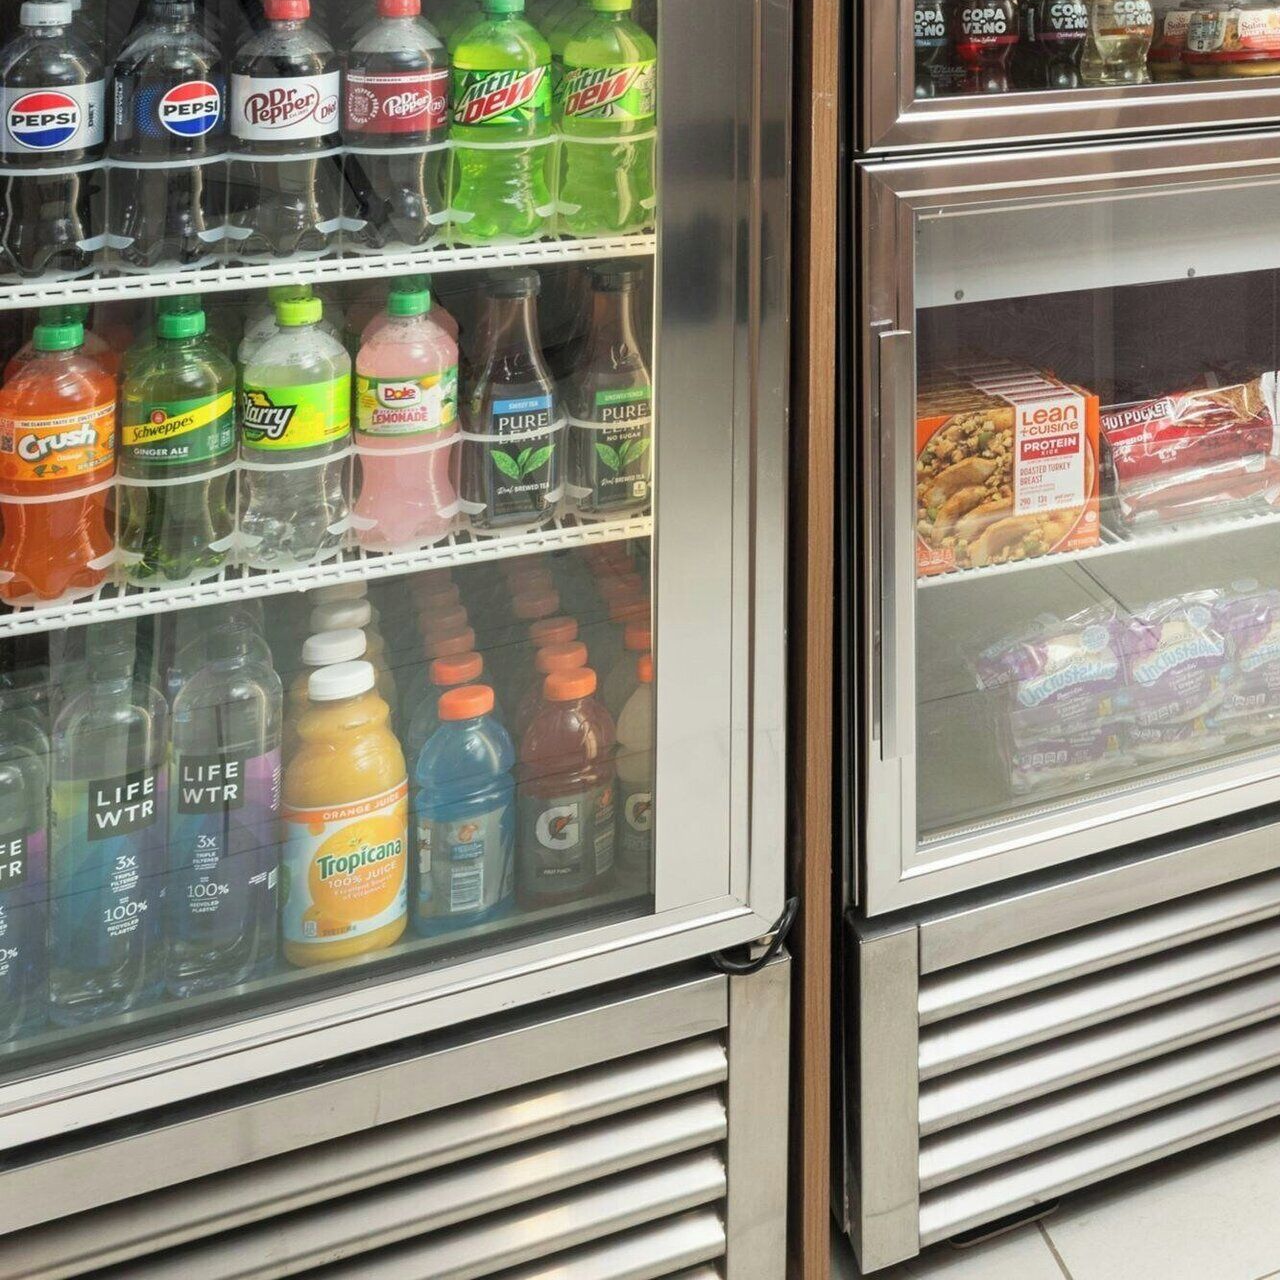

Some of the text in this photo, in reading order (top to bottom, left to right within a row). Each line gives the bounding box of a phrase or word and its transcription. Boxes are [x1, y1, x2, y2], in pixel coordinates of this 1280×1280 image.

[963, 8, 1006, 23] COPA
[1051, 4, 1087, 18] COPA
[962, 22, 1006, 35] VINO
[1051, 17, 1088, 29] VINO
[270, 87, 297, 105] Dr
[401, 92, 419, 105] Dr
[163, 99, 218, 116] PEPSI
[251, 92, 315, 125] Pepper
[388, 95, 431, 117] Pepper
[11, 113, 76, 127] PEPSI
[384, 388, 416, 401] Dole
[528, 400, 538, 408] TEA
[603, 403, 647, 421] PURE
[372, 410, 428, 425] LEMONADE
[499, 413, 548, 431] PURE
[1022, 404, 1078, 427] Lean
[1102, 414, 1124, 430] HOT
[132, 414, 194, 442] Schweppes
[619, 432, 641, 440] SUGAR
[17, 423, 97, 462] Crush
[1023, 437, 1077, 453] PROTEIN
[134, 446, 189, 457] GINGER ALE
[1020, 474, 1043, 486] BREAST
[515, 484, 538, 493] BREWED
[184, 762, 239, 782] LIFE
[97, 777, 154, 806] LIFE
[183, 784, 238, 804] WTR
[96, 799, 154, 829] WTR
[323, 792, 400, 821] ORANGE JUICE
[536, 803, 579, 850] G
[198, 835, 216, 848] 3x
[116, 855, 136, 871] 3x
[317, 837, 402, 880] Tropicana
[328, 874, 364, 889] 100%
[366, 861, 398, 880] JUICE
[187, 883, 229, 898] 100%
[104, 900, 147, 923] 100%
